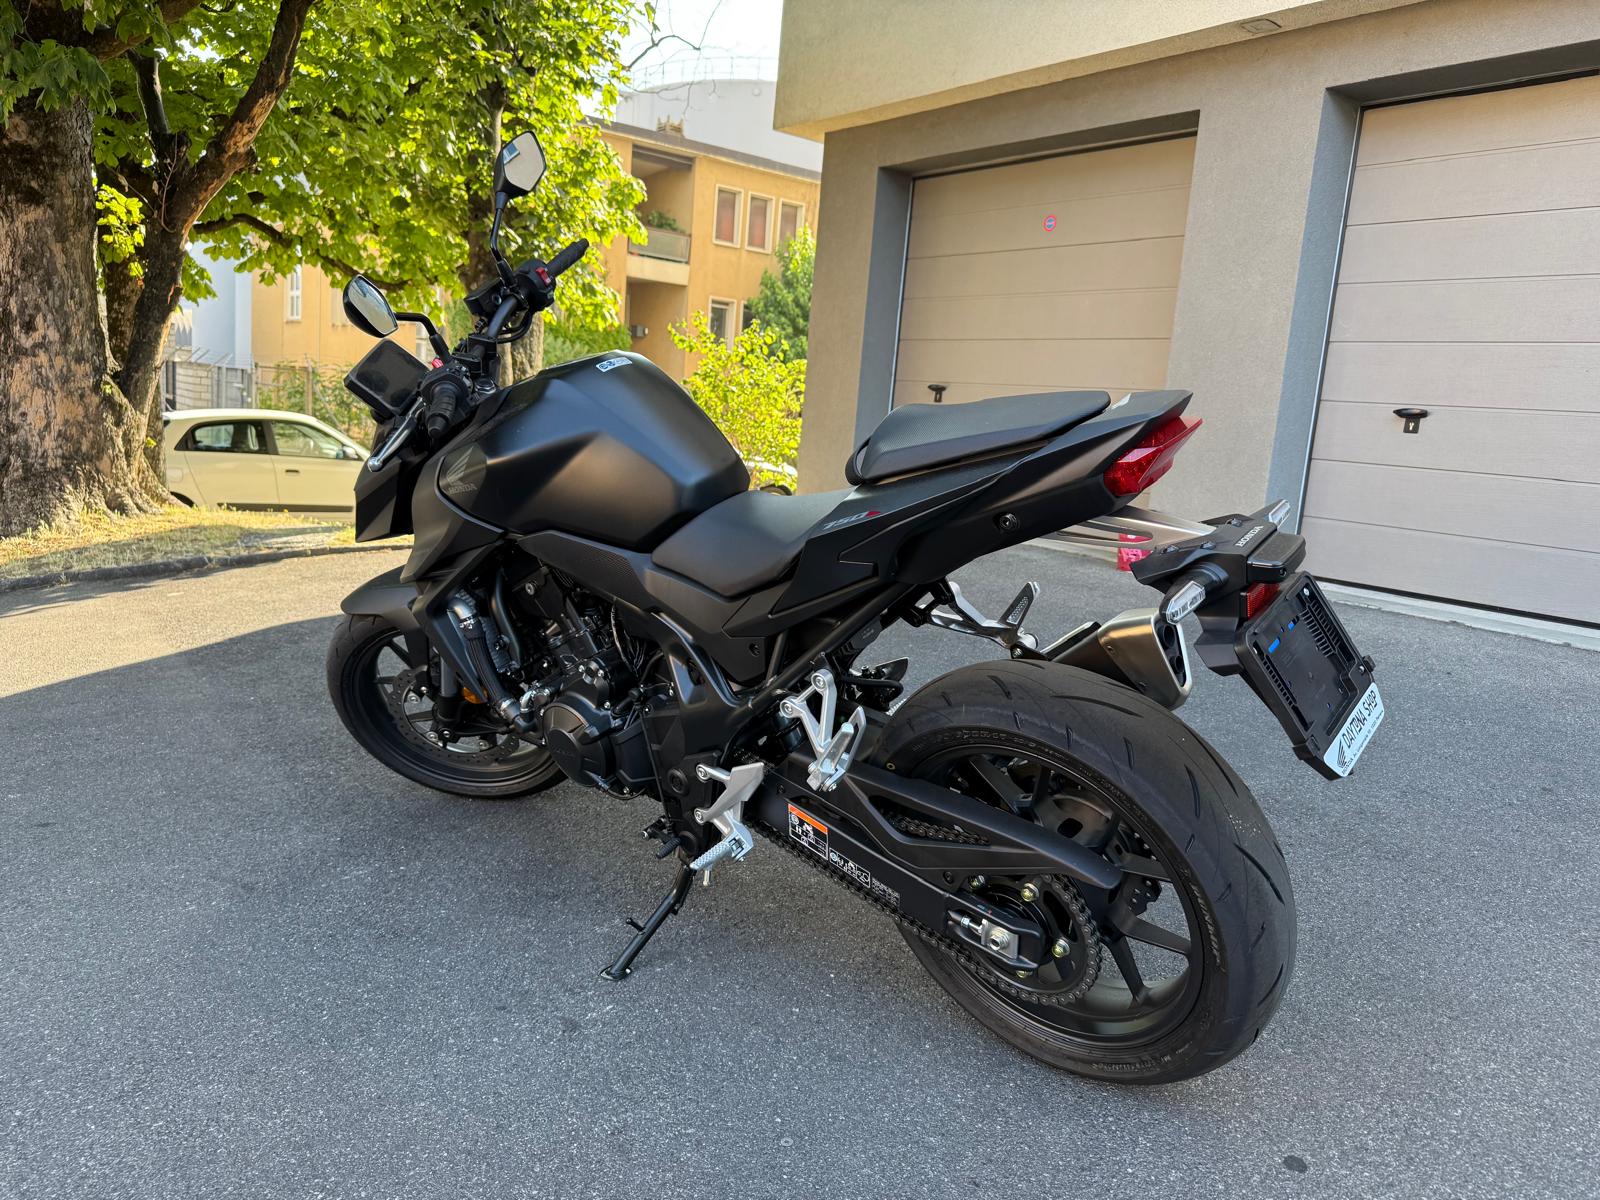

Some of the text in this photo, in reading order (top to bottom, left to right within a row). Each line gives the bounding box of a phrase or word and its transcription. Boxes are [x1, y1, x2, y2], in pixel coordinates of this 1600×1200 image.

[1235, 525, 1264, 547] HONDA
[1341, 708, 1368, 749] DAYTONA
[1362, 689, 1378, 717] SHOP
